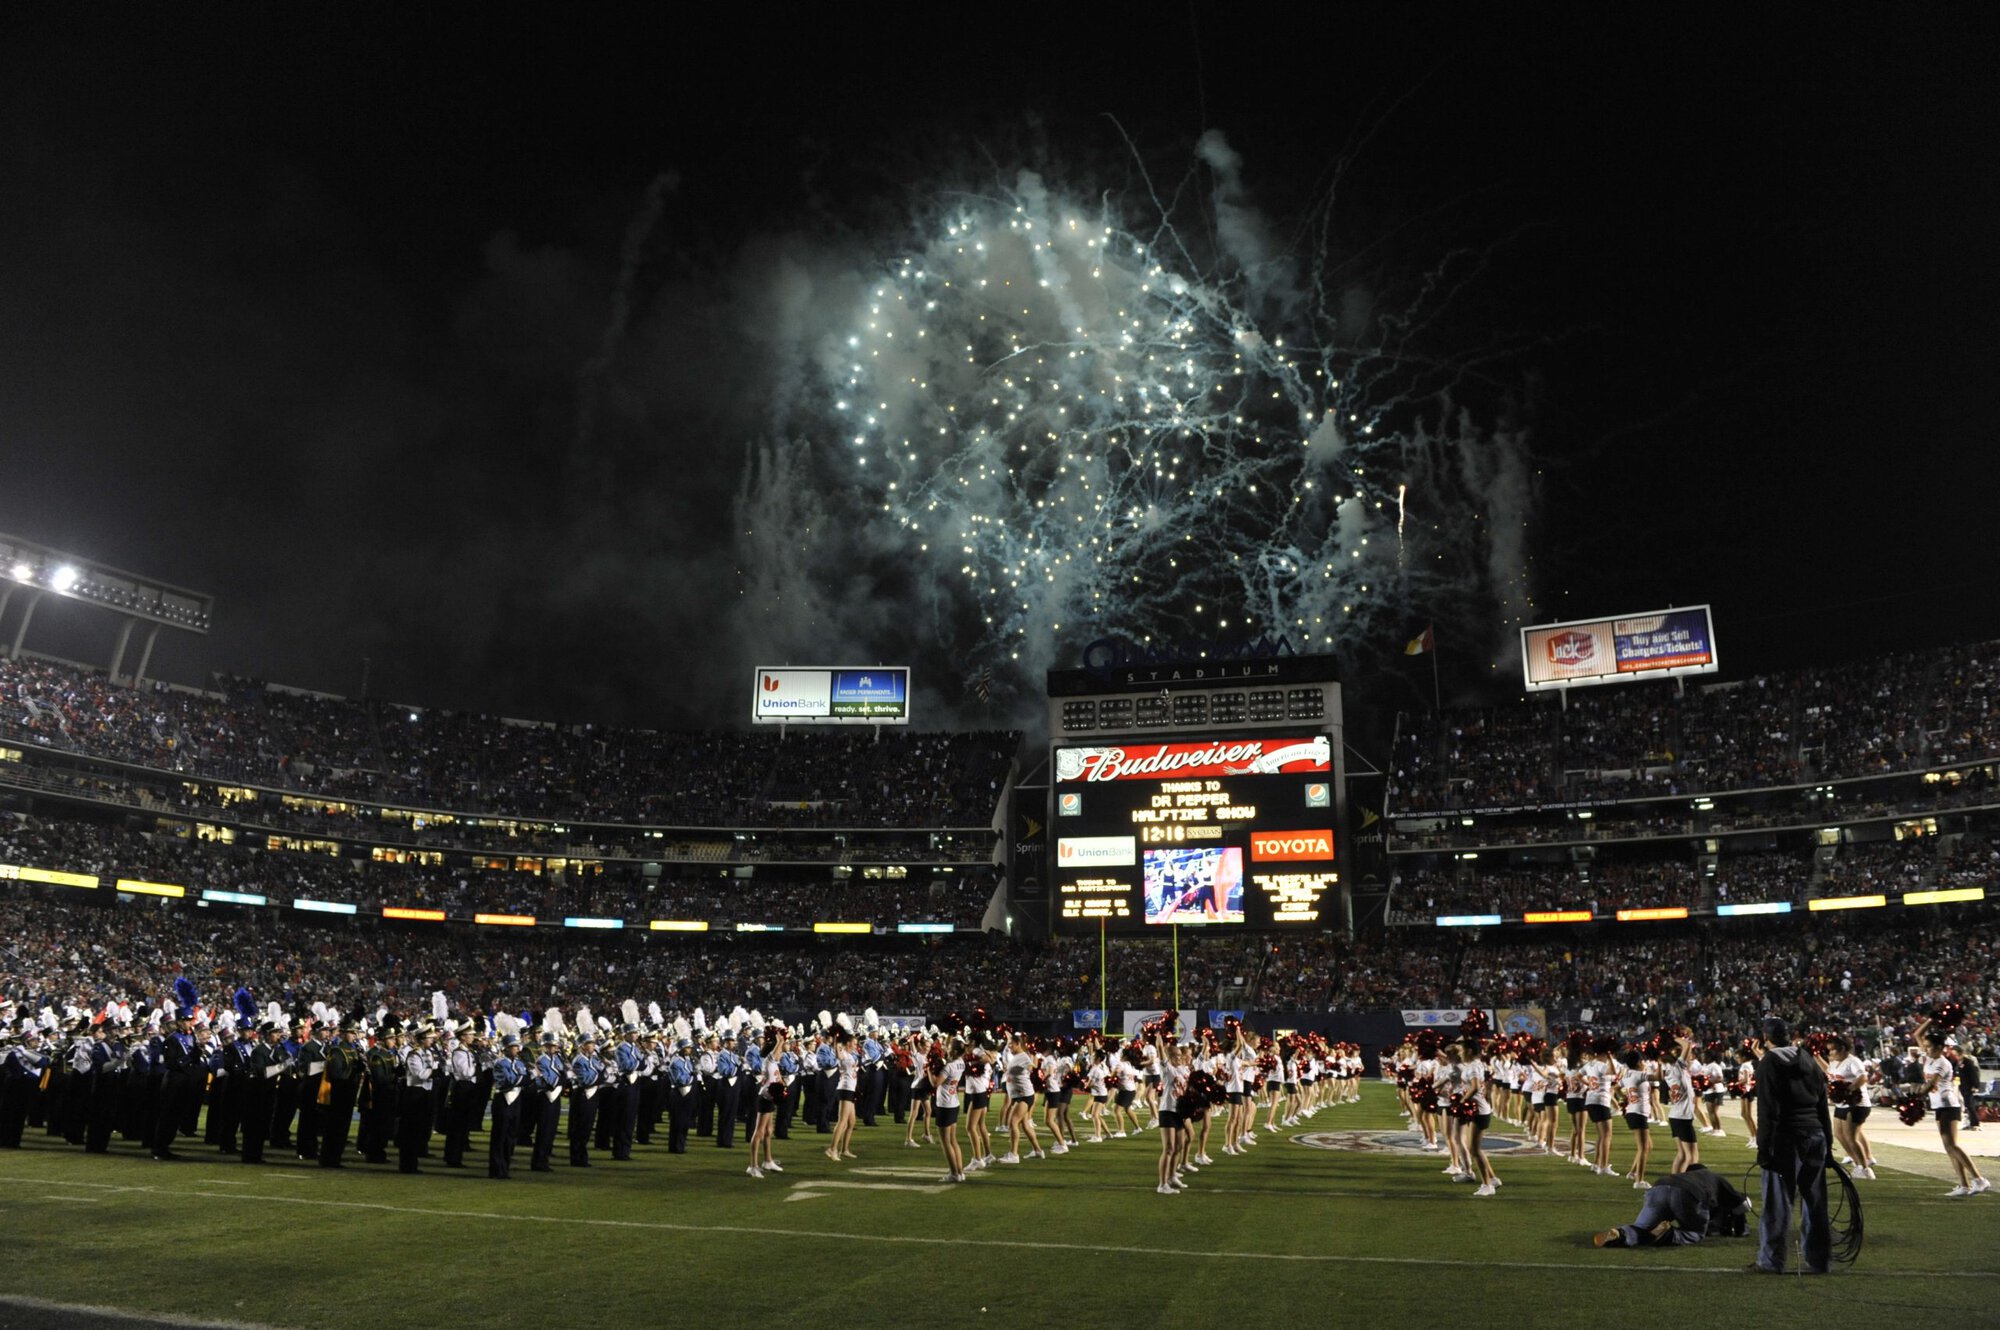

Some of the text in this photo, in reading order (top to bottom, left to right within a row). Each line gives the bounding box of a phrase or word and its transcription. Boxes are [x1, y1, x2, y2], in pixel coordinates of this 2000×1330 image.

[1632, 635, 1650, 647] Buy
[1621, 645, 1665, 658] Chargers
[1127, 664, 1279, 682] STADIUM
[762, 698, 826, 709] UnionBank
[834, 706, 857, 715] ready.
[874, 705, 901, 713] thrive.
[1082, 741, 1262, 782] Budweiser
[1160, 780, 1221, 793] THANKS TO
[1151, 792, 1230, 807] DR PEPPER
[1132, 806, 1256, 822] HALFTIME SHOW
[1078, 847, 1133, 857] UnionBank
[1254, 838, 1330, 855] TOYOTA
[1526, 911, 1590, 921] WELLS FARGO
